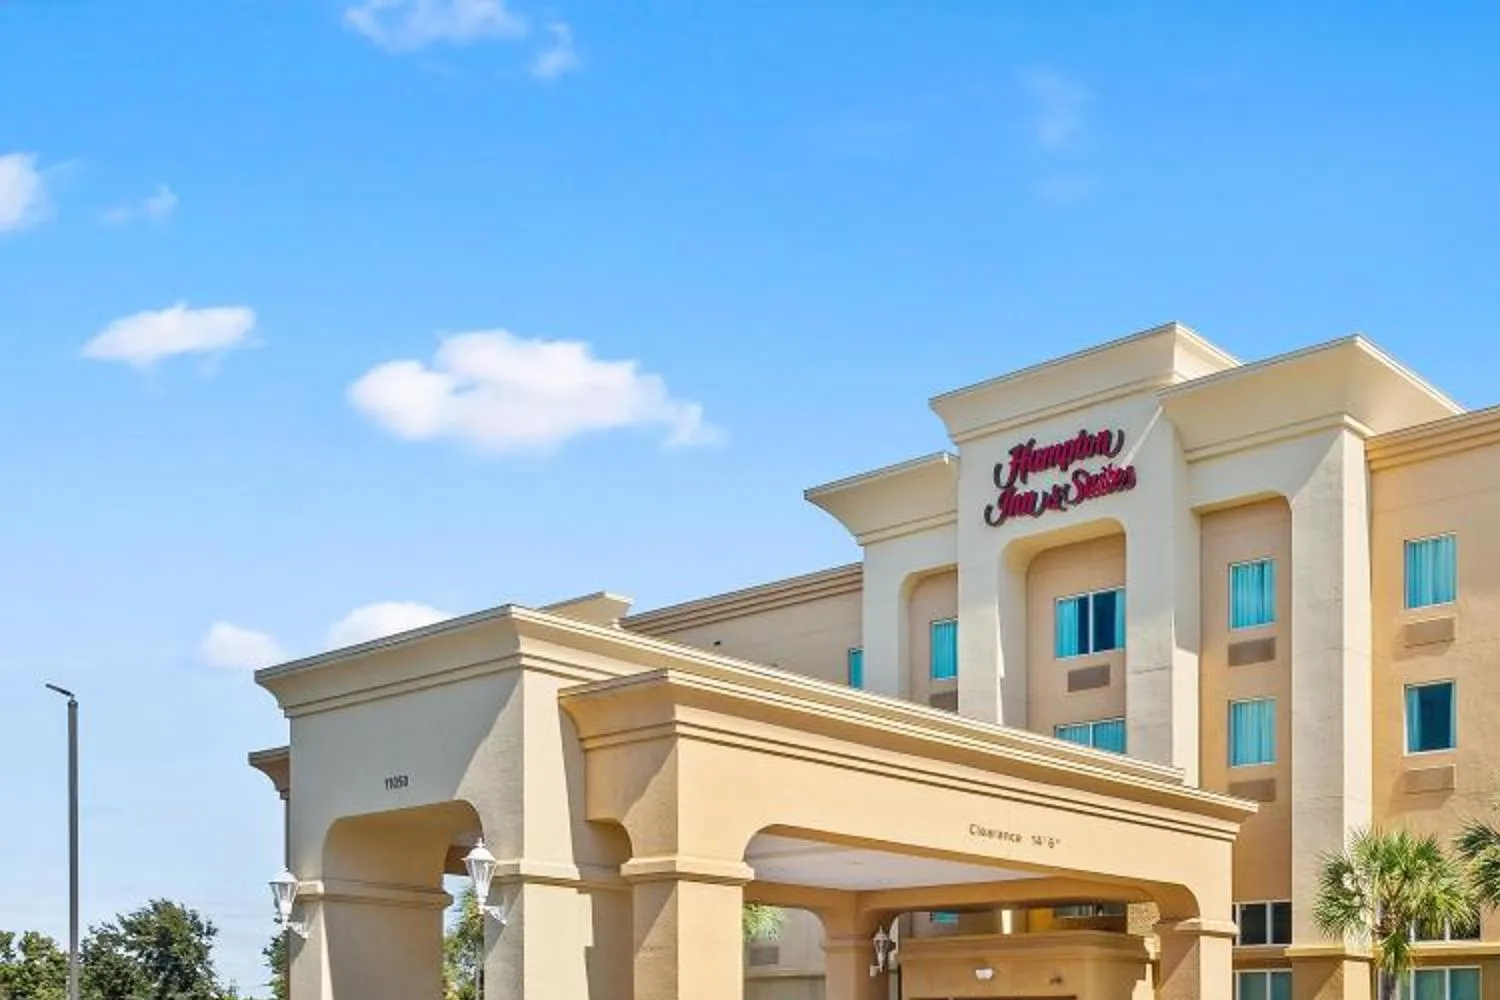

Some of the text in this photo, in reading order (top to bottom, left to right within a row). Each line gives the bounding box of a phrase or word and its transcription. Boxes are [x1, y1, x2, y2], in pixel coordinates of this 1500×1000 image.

[993, 429, 1125, 489] Hampton
[983, 464, 1136, 527] Inn & Suites
